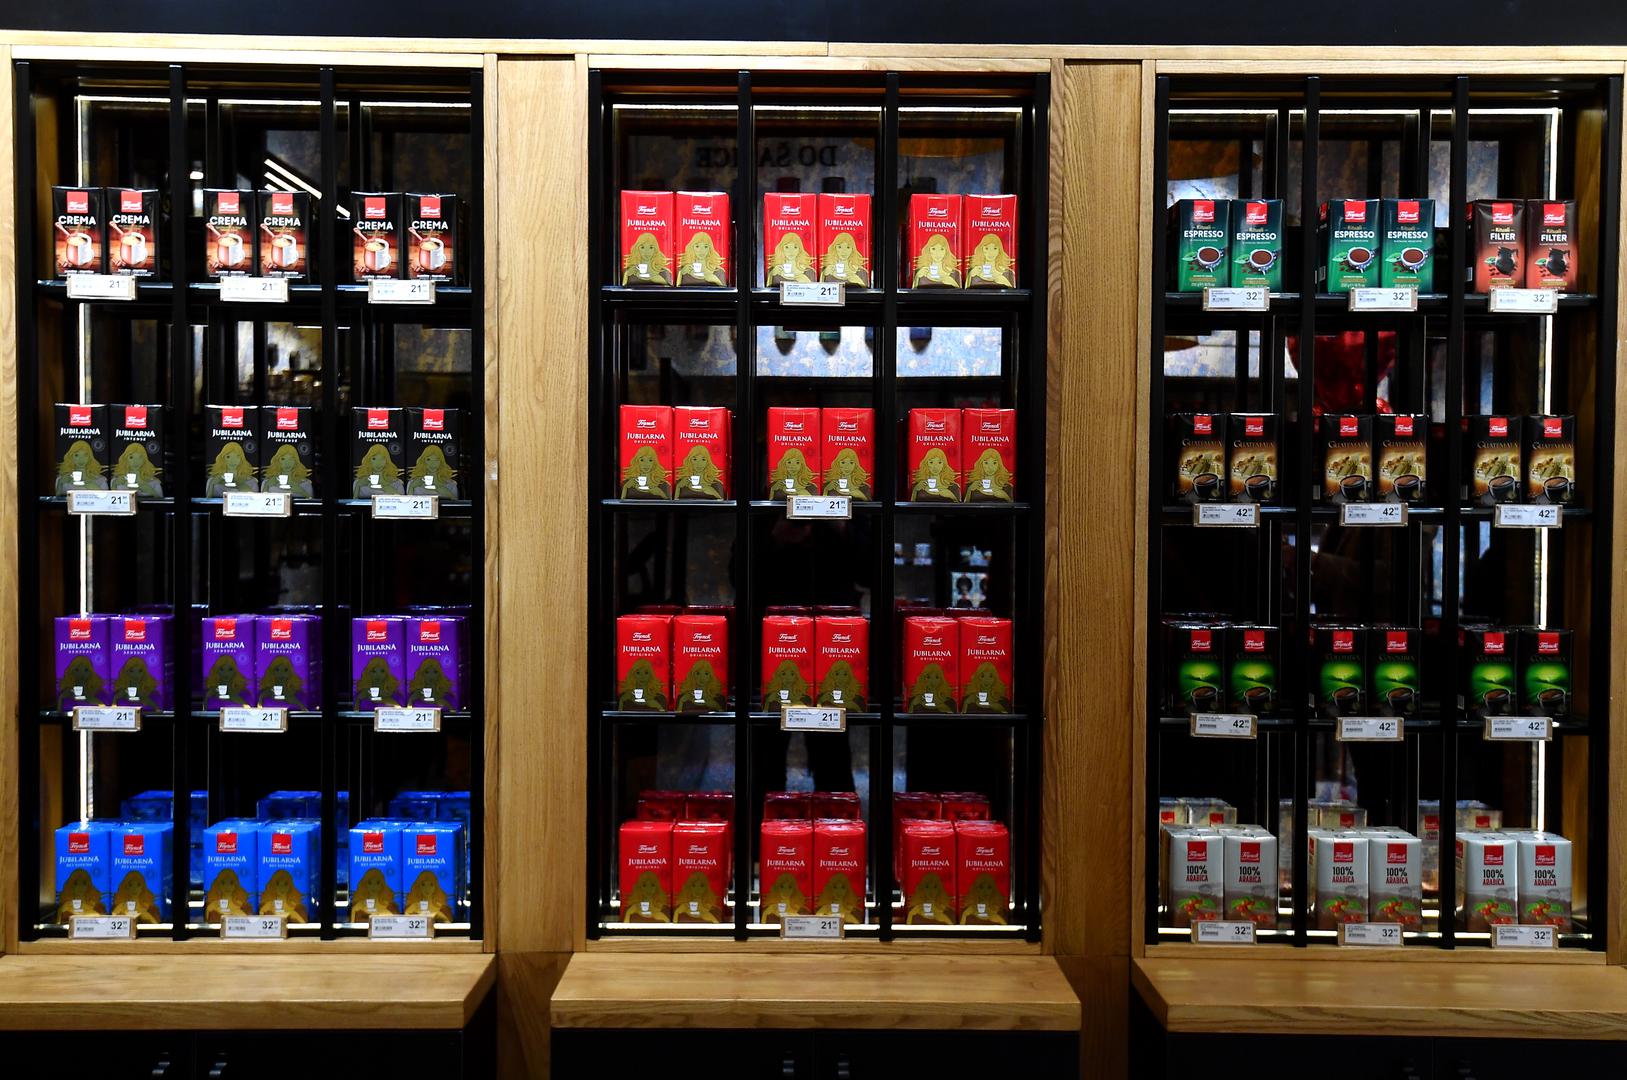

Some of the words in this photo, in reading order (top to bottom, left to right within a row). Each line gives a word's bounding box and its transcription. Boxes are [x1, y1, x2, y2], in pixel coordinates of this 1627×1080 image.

[58, 216, 96, 225] CREMA
[112, 215, 150, 224] CREMA
[210, 217, 247, 226] CREMA
[264, 217, 301, 226] CREMA
[682, 218, 720, 226] JUBILARNA
[356, 221, 393, 230] CREMA
[412, 221, 448, 230] CREMA
[1184, 230, 1224, 238] ESPRESSO
[1388, 231, 1428, 239] ESPRESSO
[1541, 234, 1567, 242] FILTER
[60, 428, 100, 436] JUBILARNA
[116, 429, 155, 437] JUBILARNA
[212, 429, 252, 437] JUBILARNA
[268, 431, 306, 439] JUBILARNA
[358, 431, 397, 439] JUBILARNA
[414, 432, 452, 440] JUBILARNA
[60, 642, 100, 650] JUBILARNA
[262, 642, 300, 650] JUBILARNA
[411, 644, 449, 652] JUBILARNA
[683, 646, 720, 654] JUBILARNA
[822, 646, 860, 654] JUBILARNA
[60, 856, 100, 864] JUBILARNA
[263, 856, 300, 864] JUBILARNA
[1187, 866, 1207, 874] 100%
[1240, 866, 1260, 875] 100%
[1332, 866, 1353, 875] 100%
[1386, 868, 1407, 876] 100%
[1483, 869, 1504, 878] 100%
[1534, 870, 1555, 878] 100%
